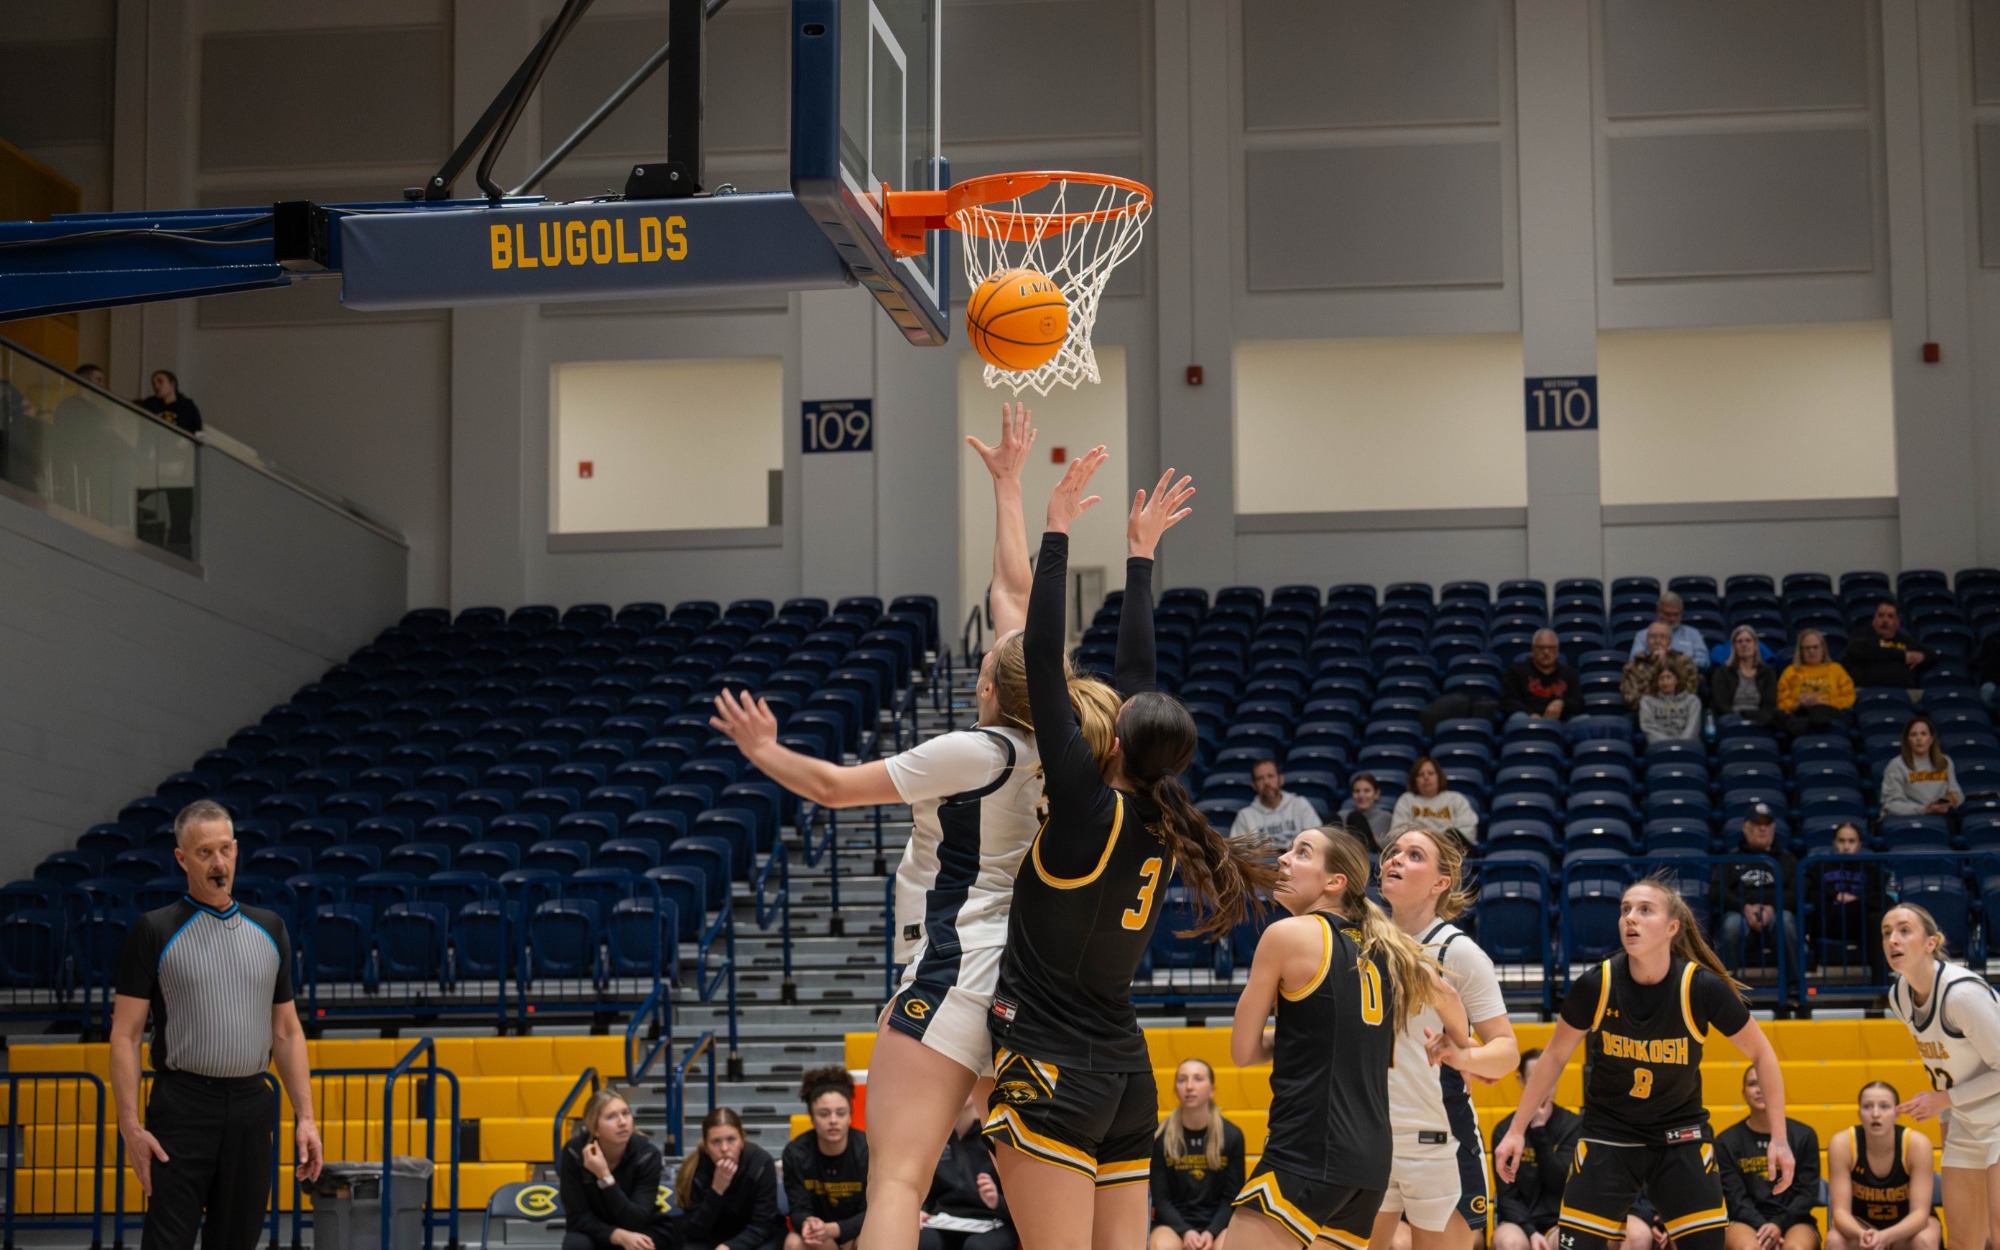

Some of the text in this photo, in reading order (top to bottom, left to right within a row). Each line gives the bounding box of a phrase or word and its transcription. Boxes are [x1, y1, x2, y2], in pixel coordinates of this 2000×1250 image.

[490, 216, 688, 270] BLUGOLDS
[805, 410, 870, 449] 109
[1532, 388, 1591, 427] 110
[1121, 857, 1162, 930] 3
[1357, 957, 1384, 1026] 0
[1601, 1030, 1688, 1065] OSHKOSH
